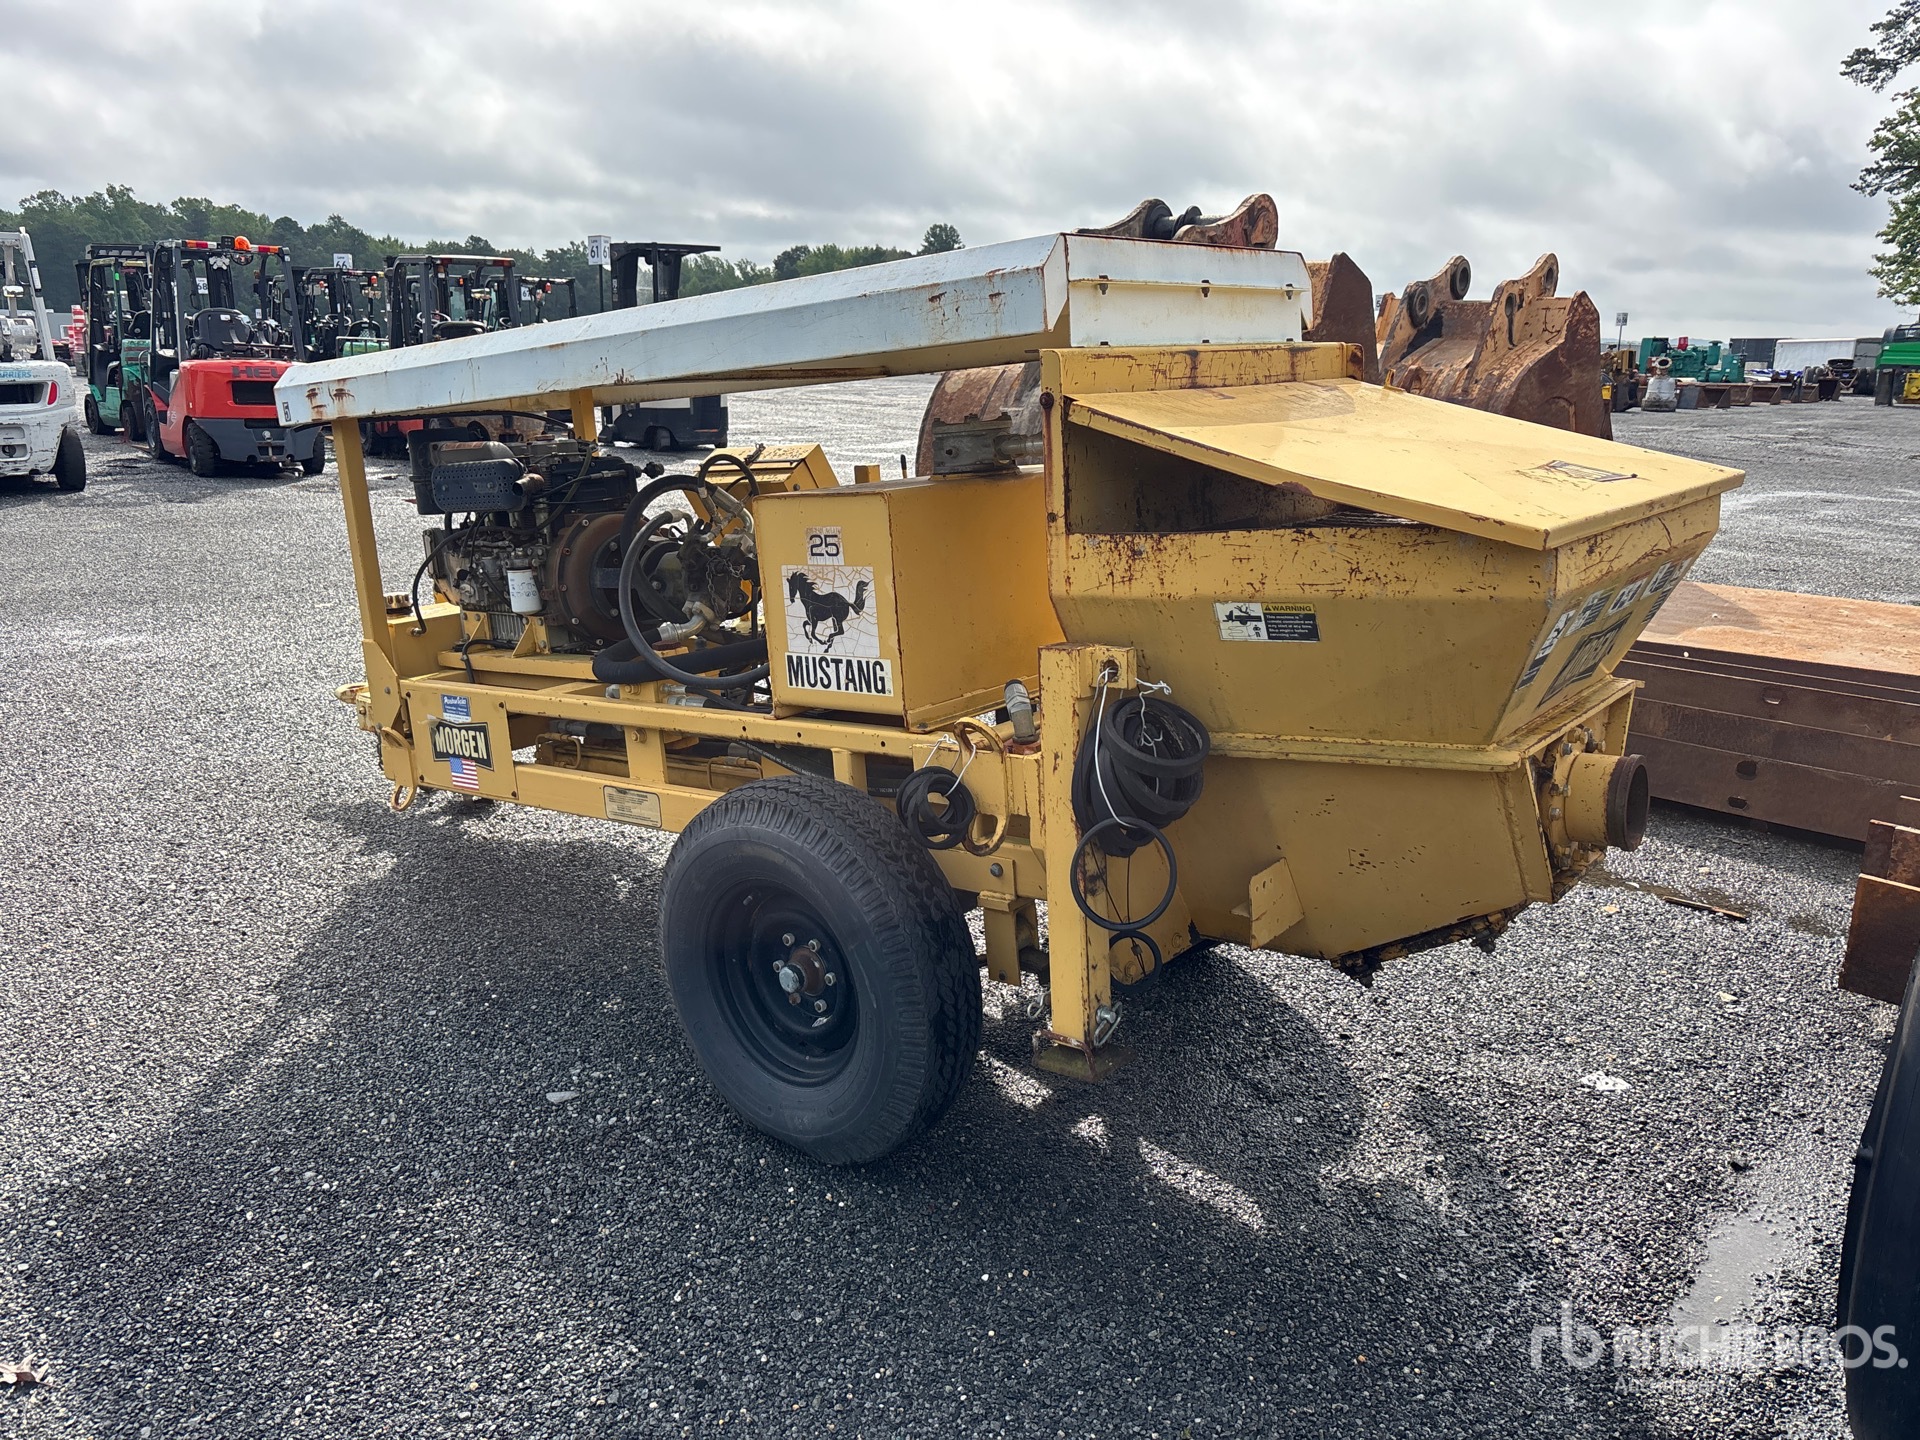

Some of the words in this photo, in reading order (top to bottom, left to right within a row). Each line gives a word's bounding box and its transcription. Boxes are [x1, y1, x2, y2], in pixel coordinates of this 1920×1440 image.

[590, 245, 599, 259] 61
[336, 260, 348, 269] 66
[232, 366, 283, 378] HEL
[808, 534, 840, 557] 25
[786, 654, 887, 695] MUSTANG
[435, 726, 488, 759] MORGEN
